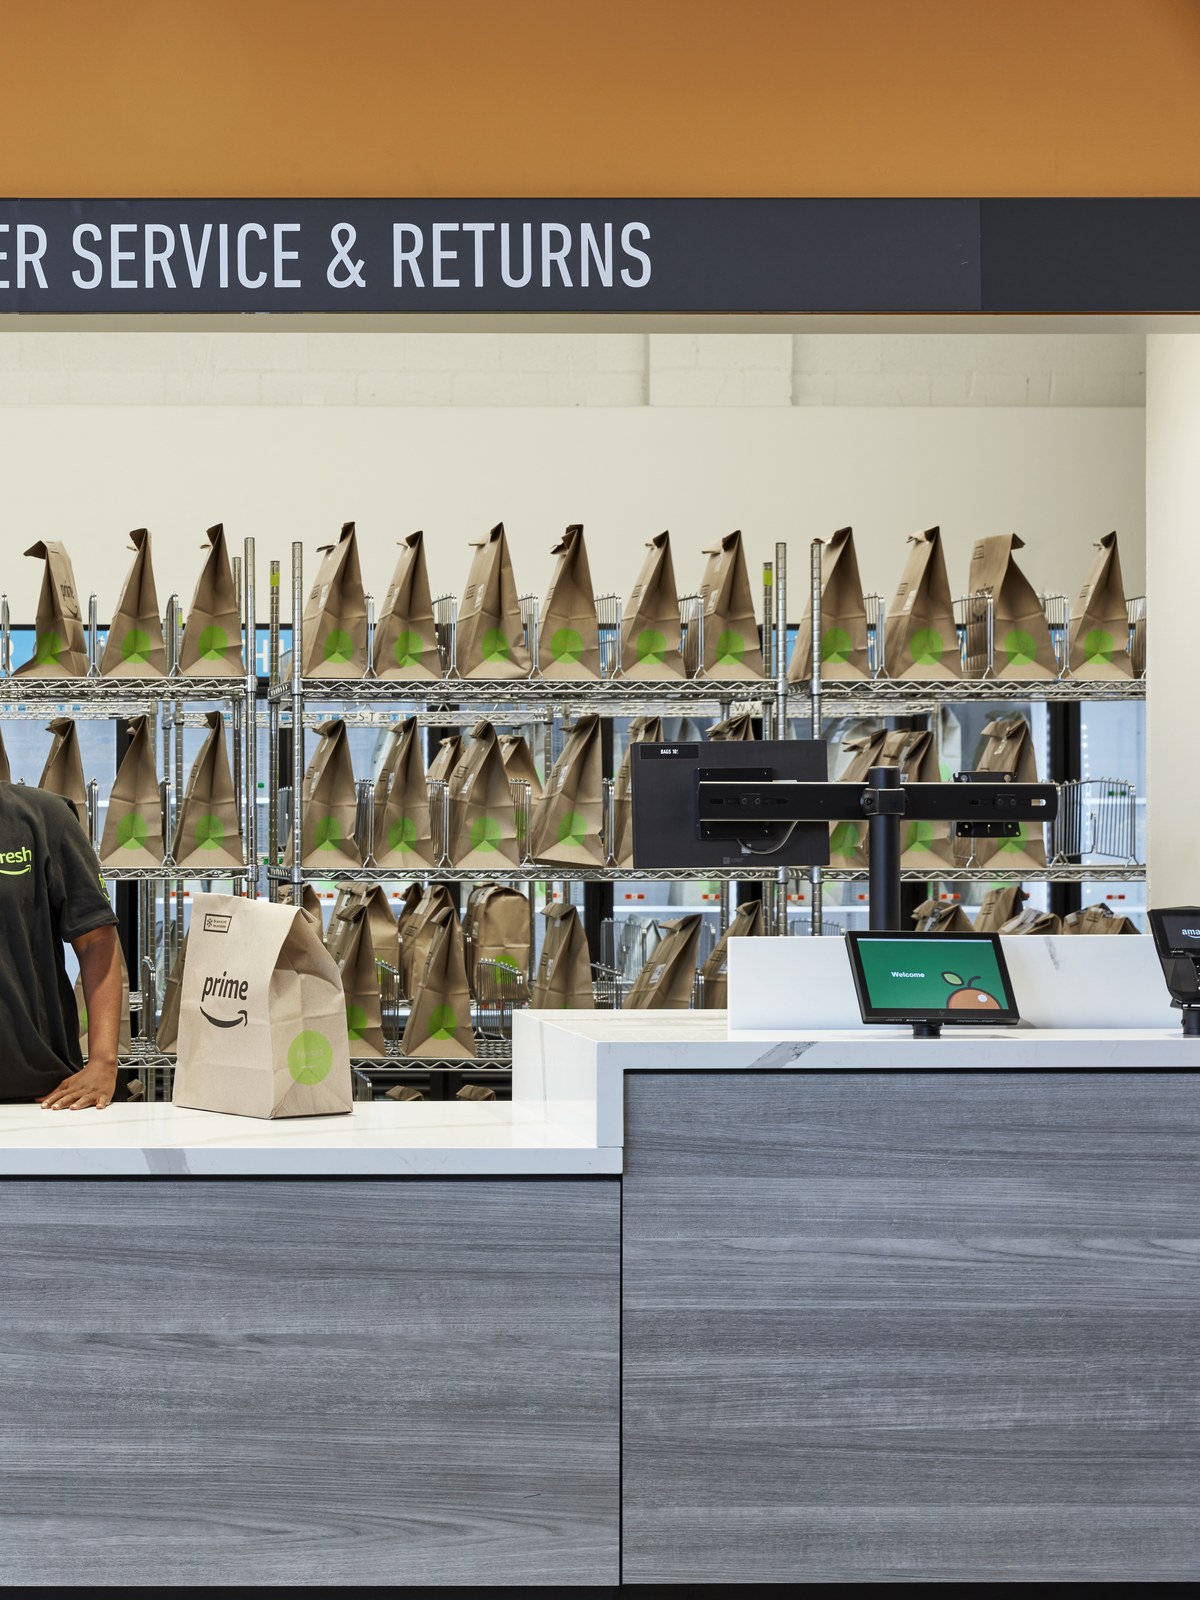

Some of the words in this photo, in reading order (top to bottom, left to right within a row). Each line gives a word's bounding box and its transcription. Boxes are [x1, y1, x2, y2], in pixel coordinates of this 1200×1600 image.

[71, 223, 301, 289] SERVICE
[326, 223, 365, 288] &
[393, 222, 651, 288] RETURNS
[358, 712, 375, 722] S-T
[201, 971, 249, 1002] prime
